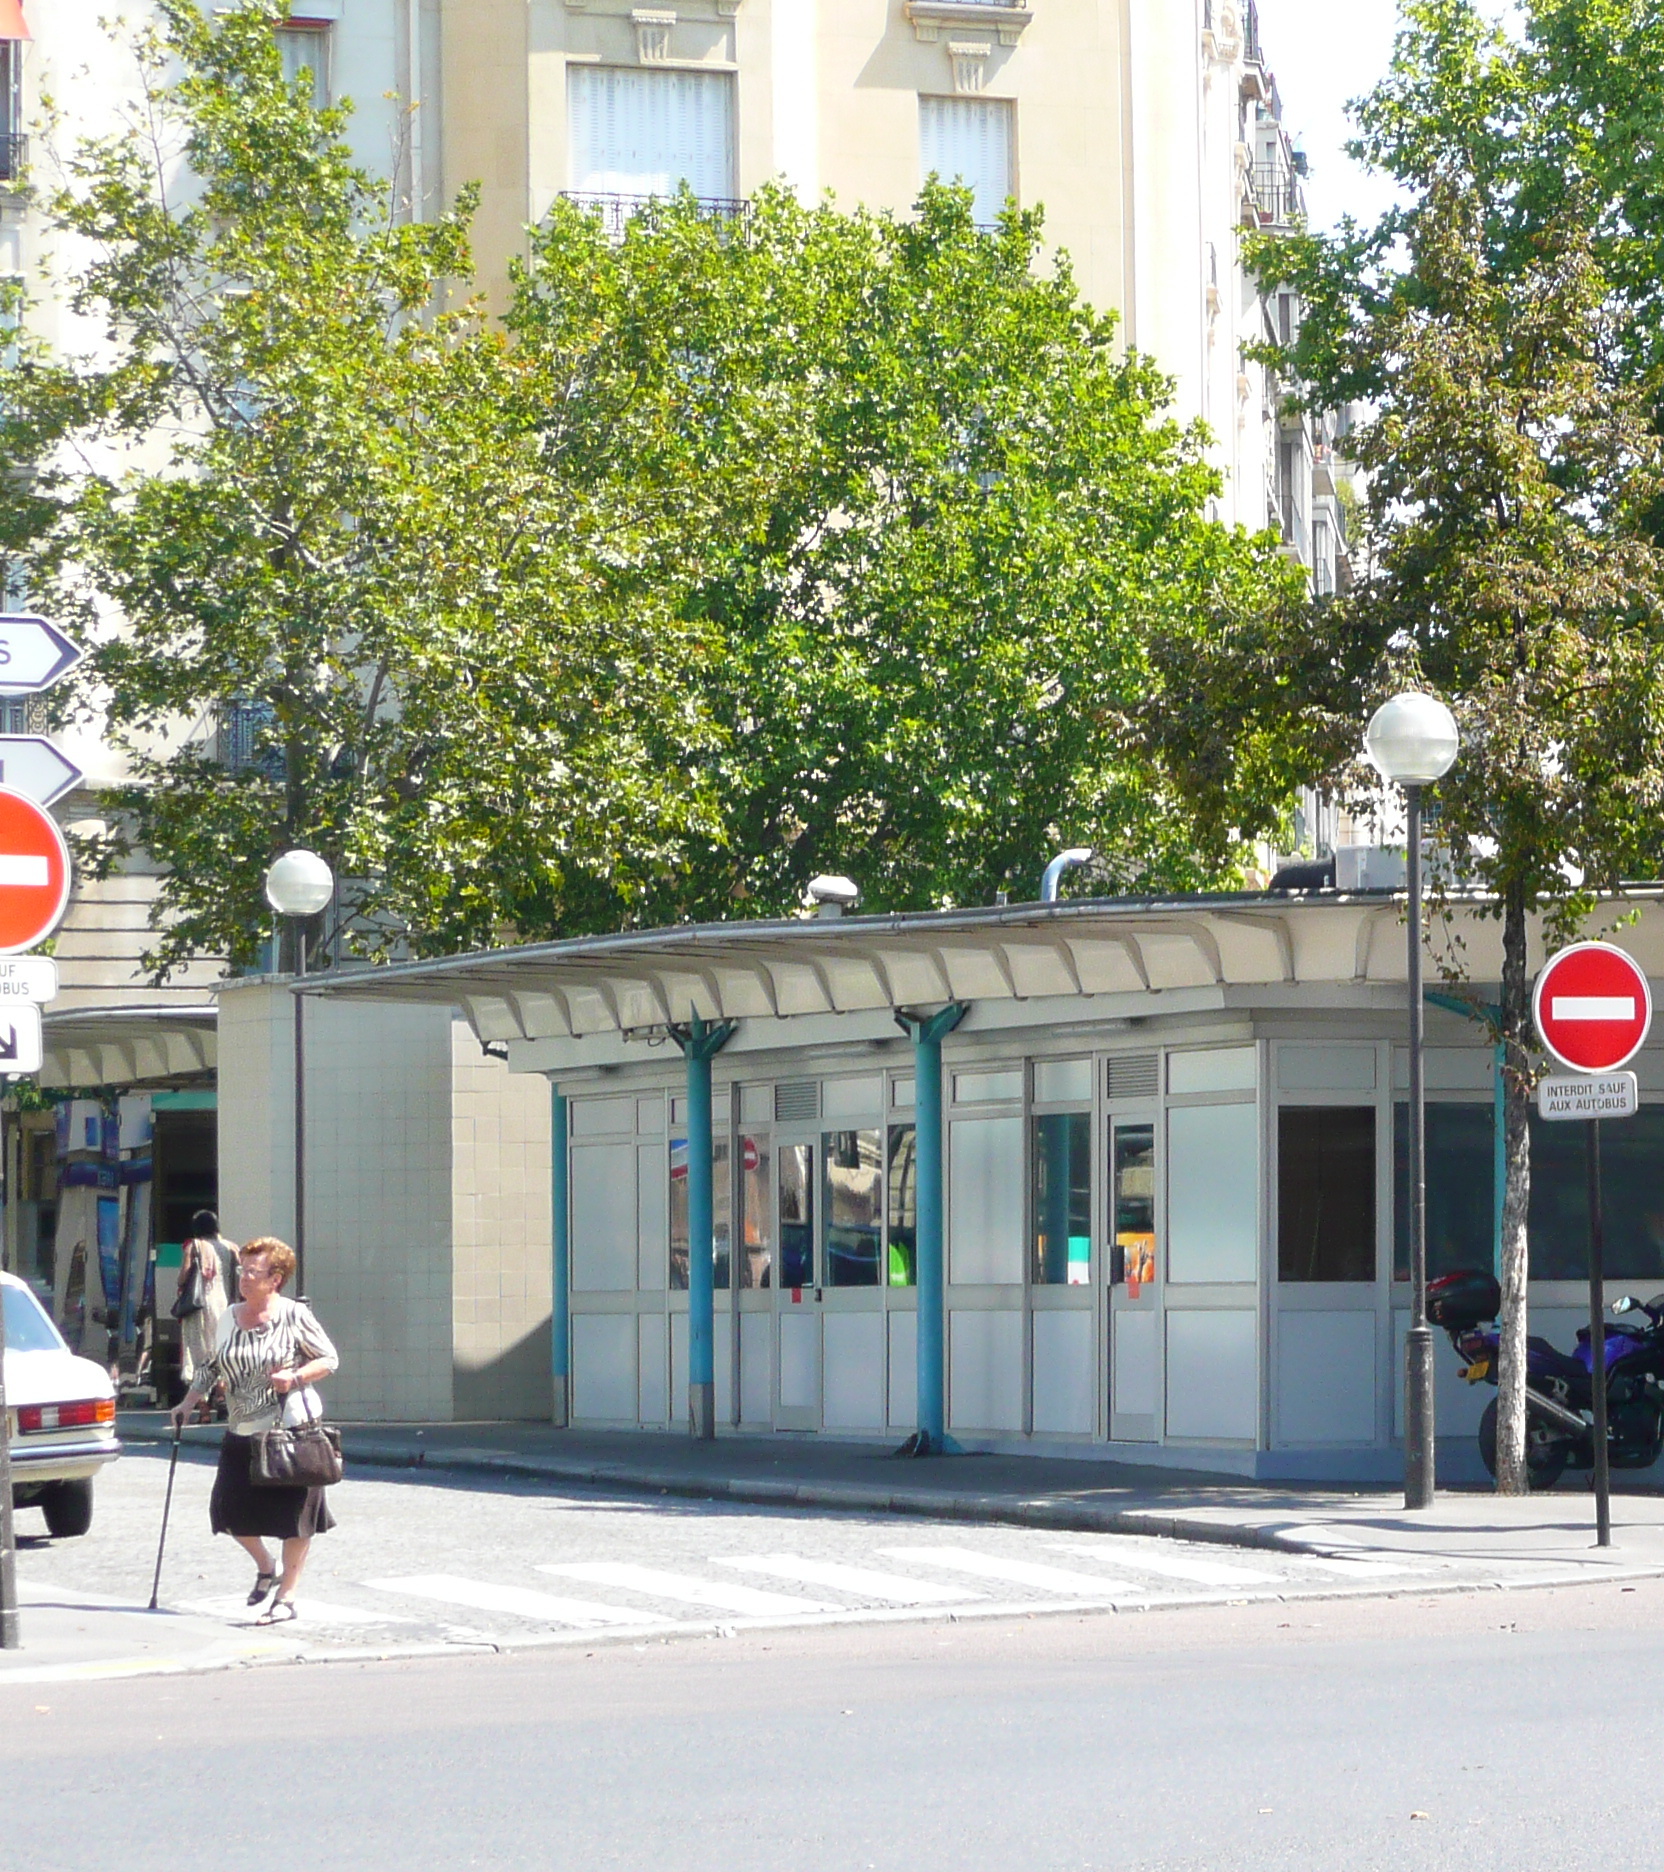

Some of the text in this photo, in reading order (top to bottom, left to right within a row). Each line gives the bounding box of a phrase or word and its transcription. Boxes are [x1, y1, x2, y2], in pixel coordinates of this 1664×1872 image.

[1547, 1082, 1626, 1098] INTERDIT SAUF
[1549, 1098, 1627, 1112] AUX AUTOBUS
